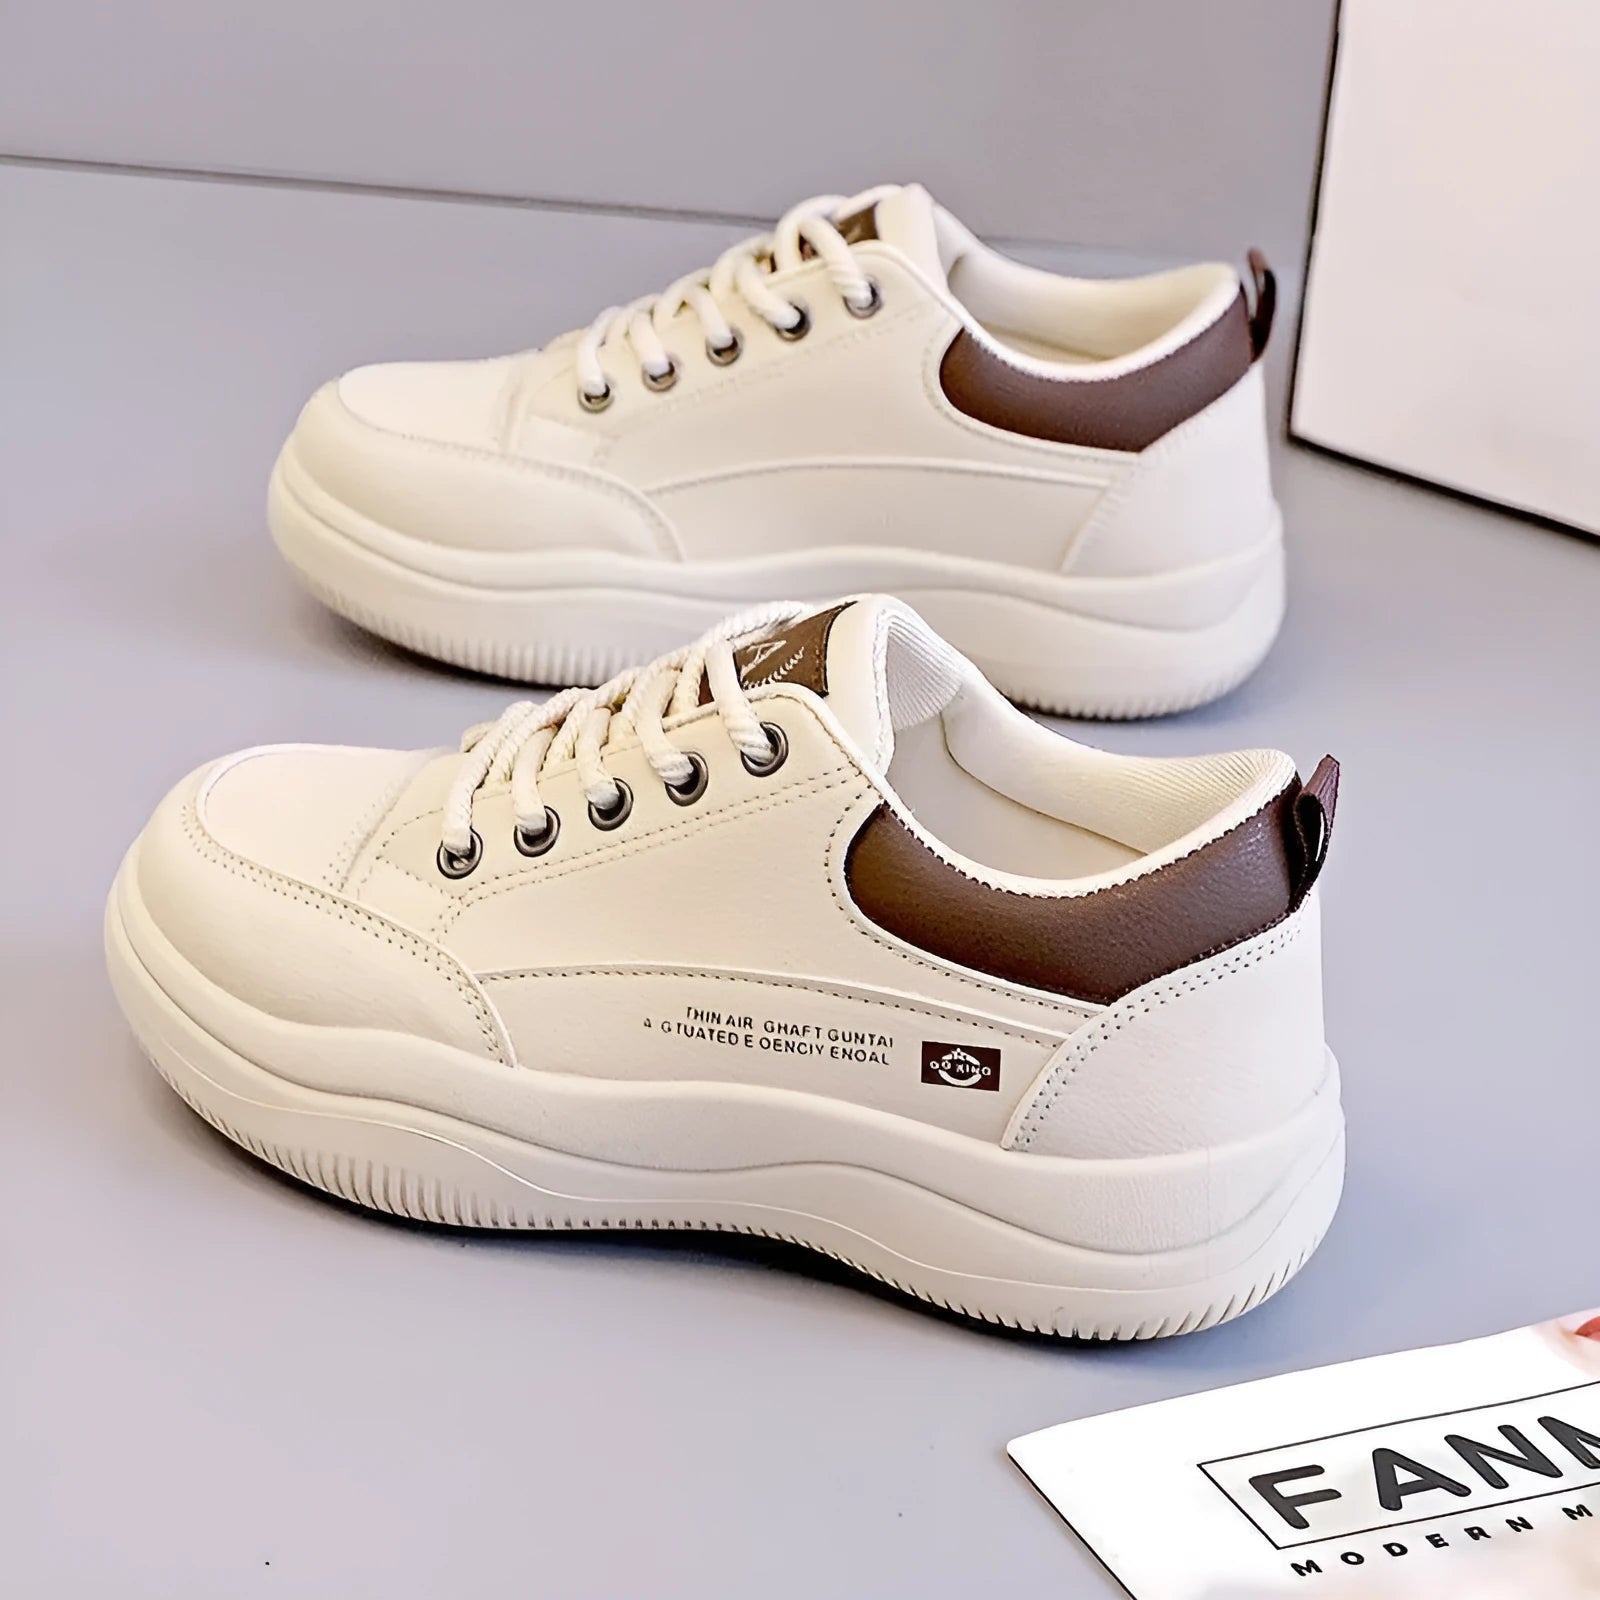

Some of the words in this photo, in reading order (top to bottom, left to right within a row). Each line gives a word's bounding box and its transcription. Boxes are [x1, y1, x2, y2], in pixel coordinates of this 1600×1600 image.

[686, 1006, 721, 1025] THIN
[725, 1014, 753, 1030] AIR
[1290, 1516, 1534, 1577] MODERN
